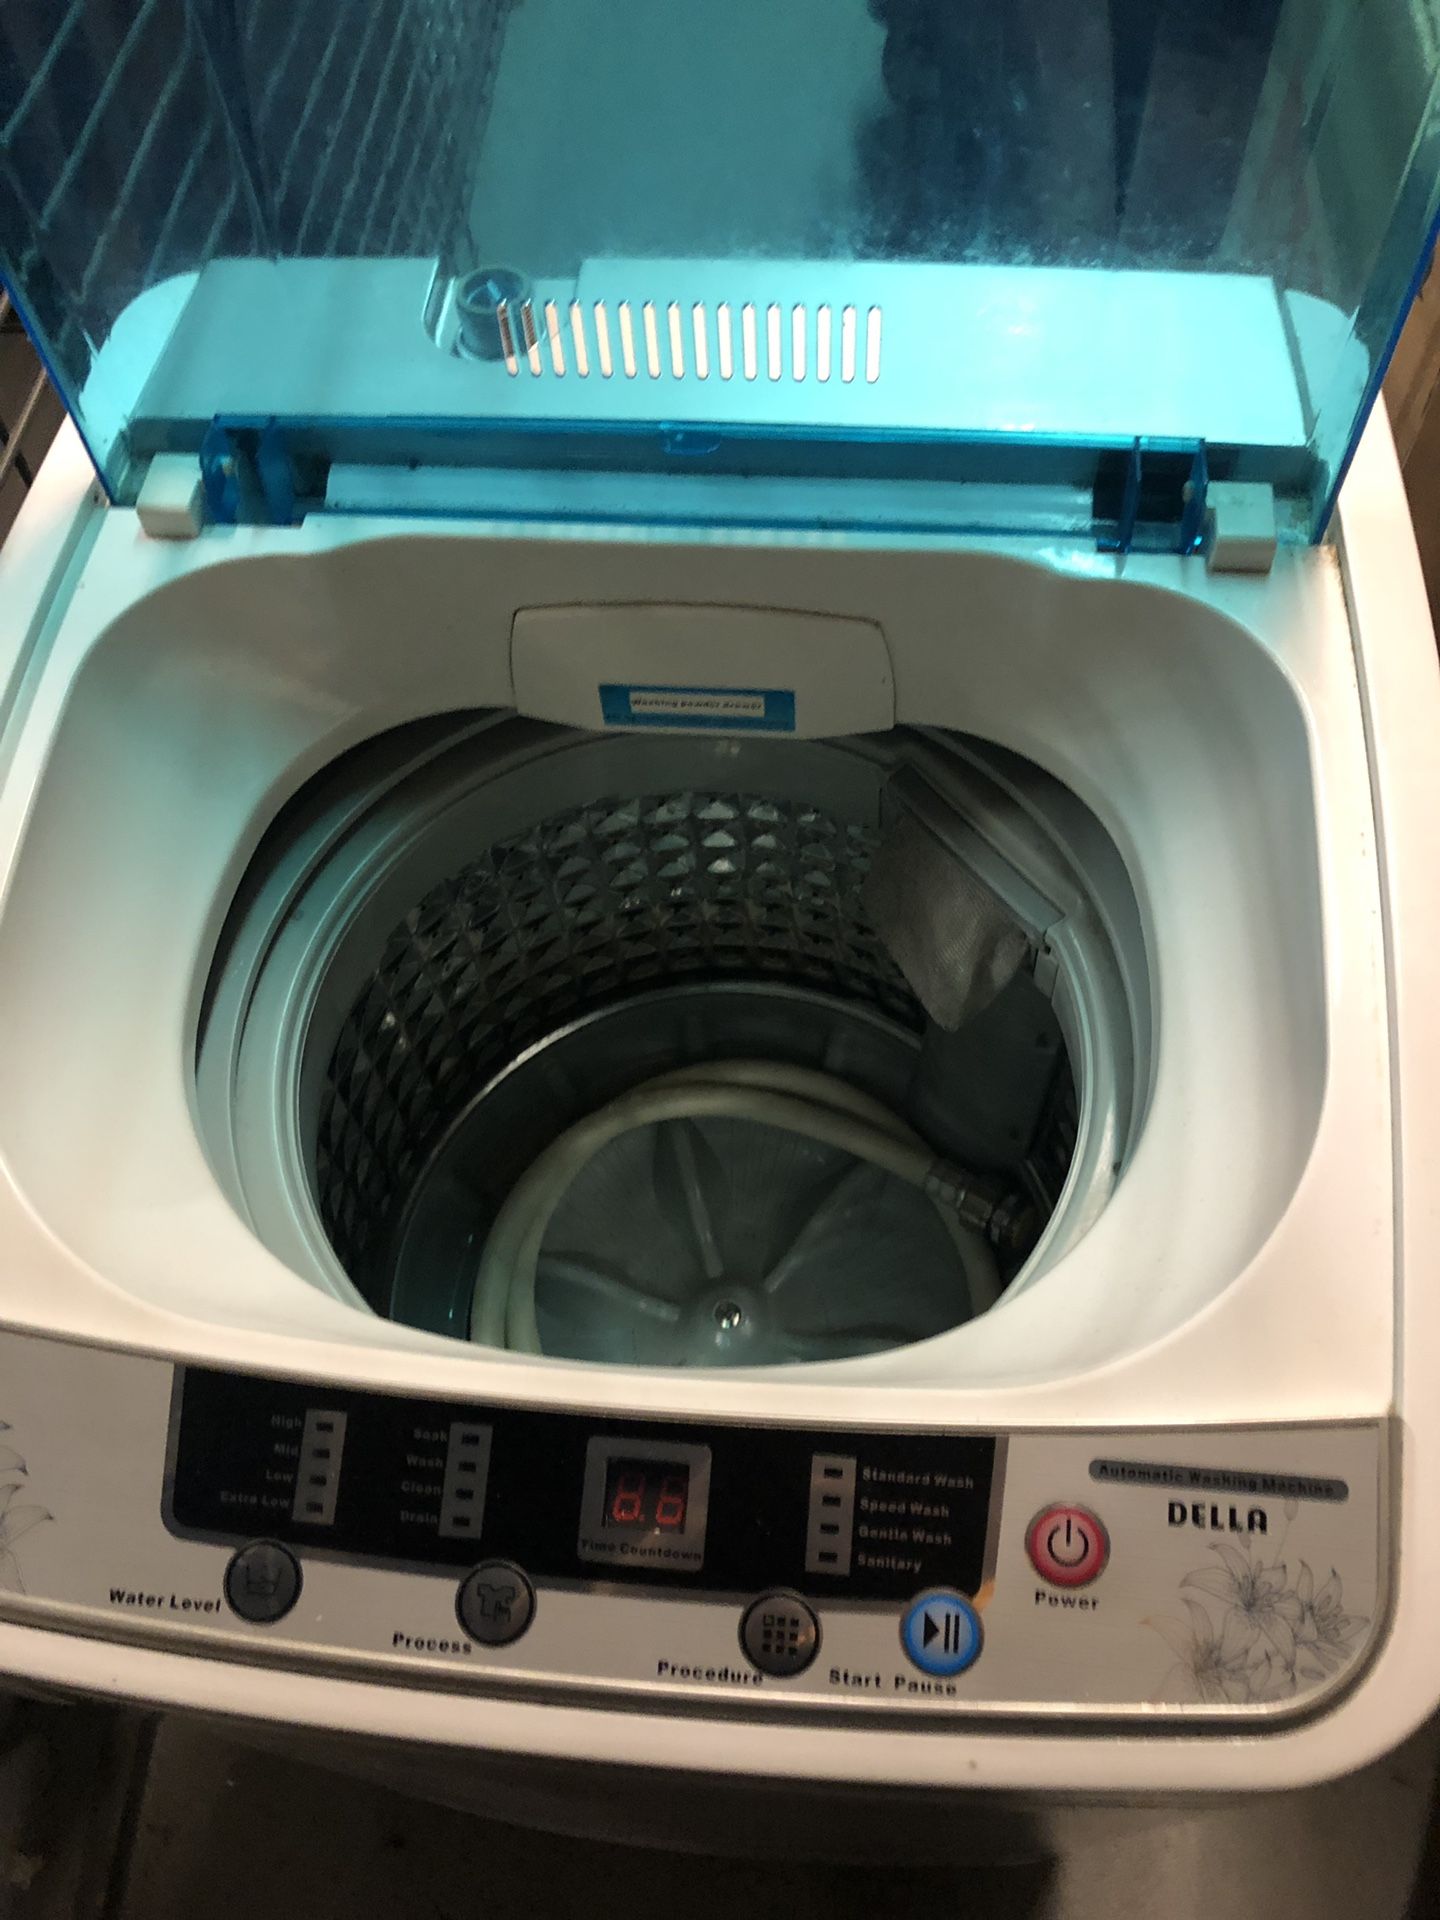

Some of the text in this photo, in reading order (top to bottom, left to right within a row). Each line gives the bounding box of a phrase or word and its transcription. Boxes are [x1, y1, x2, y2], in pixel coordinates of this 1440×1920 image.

[406, 1454, 444, 1468] Wash
[265, 1468, 294, 1483] Low
[862, 1465, 974, 1490] Standard Wash
[1099, 1463, 1335, 1496] Automatic Washing Machine
[261, 1495, 291, 1509] Low
[860, 1497, 950, 1519] Speed Wash
[1167, 1501, 1268, 1535] DELLA
[858, 1526, 952, 1546] Gentle Wash
[619, 1542, 701, 1561] Countdown
[858, 1552, 922, 1573] Sanitary
[109, 1588, 221, 1614] Water Level
[1035, 1589, 1099, 1611] Power
[392, 1631, 472, 1656] Process
[657, 1659, 764, 1688] Procedure
[829, 1668, 957, 1697] Start Pause
